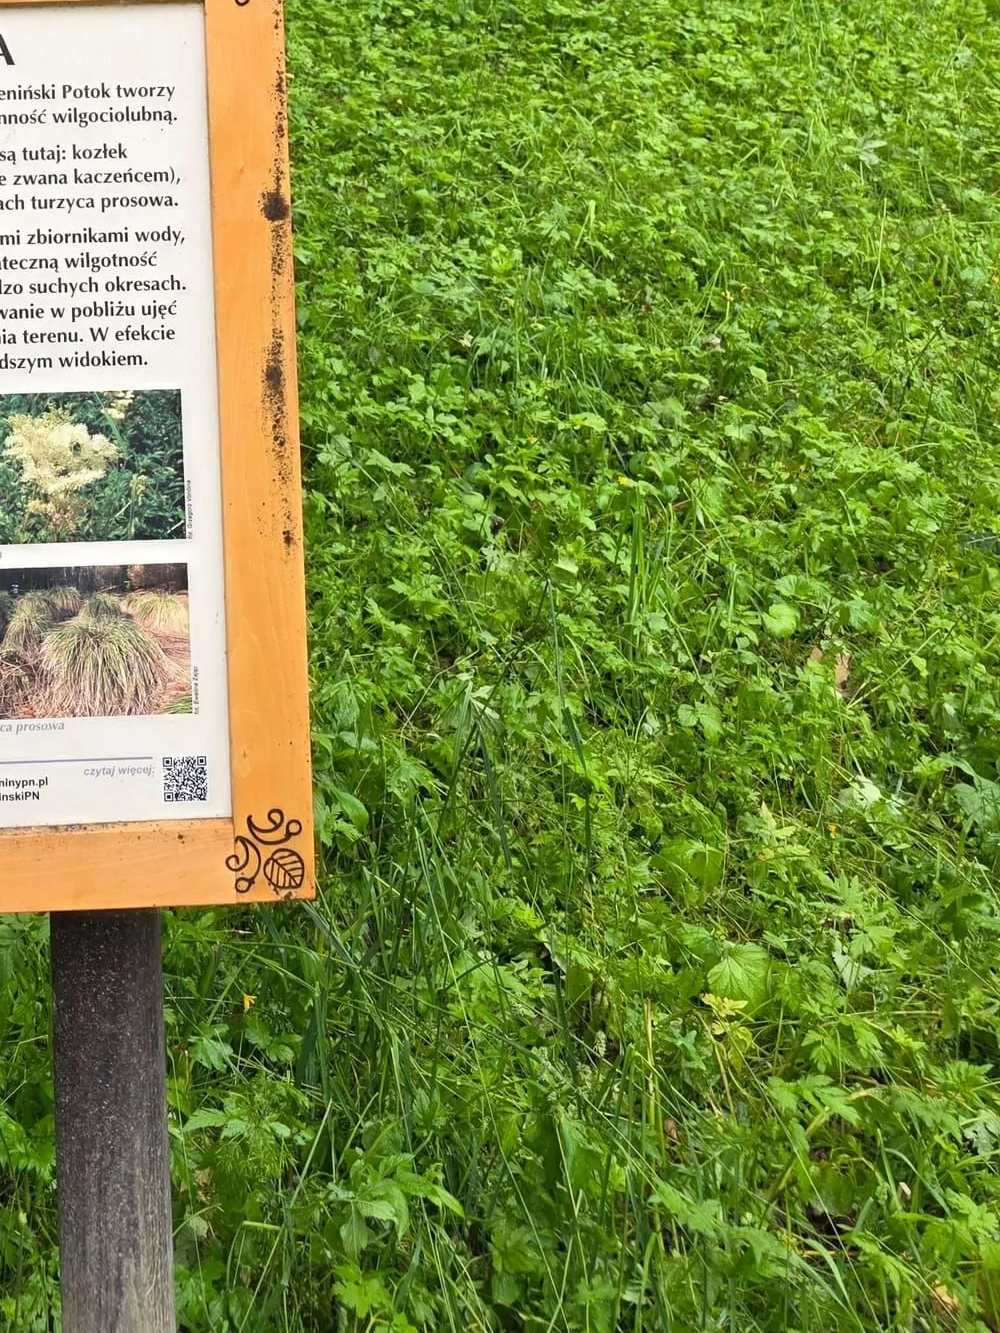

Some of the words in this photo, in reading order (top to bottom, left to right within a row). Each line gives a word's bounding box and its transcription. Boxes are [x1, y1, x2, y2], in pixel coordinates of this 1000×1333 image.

[63, 83, 110, 98] Potok
[117, 85, 175, 101] tworzy
[53, 106, 177, 127] wilgociolubną.
[0, 151, 16, 165] są
[22, 145, 65, 163] tutaj:
[73, 143, 127, 159] kozłek
[13, 174, 67, 185] zwana
[74, 167, 180, 184] kaczeńcem),
[31, 196, 94, 213] turzyca
[101, 196, 178, 213] prosowa.
[27, 227, 128, 244] zbiornikami
[135, 226, 184, 246] wody,
[65, 251, 156, 272] wilgotność
[29, 277, 98, 298] suchych
[105, 275, 186, 292] okresach.
[51, 308, 65, 318] w
[72, 301, 135, 322] pobliżu
[142, 300, 176, 319] ujęć
[23, 330, 83, 344] terenu.
[90, 327, 108, 341] W
[115, 325, 175, 341] efekcie
[59, 351, 147, 367] widokiem.
[16, 721, 65, 734] prosowa
[83, 767, 114, 779] czytaj
